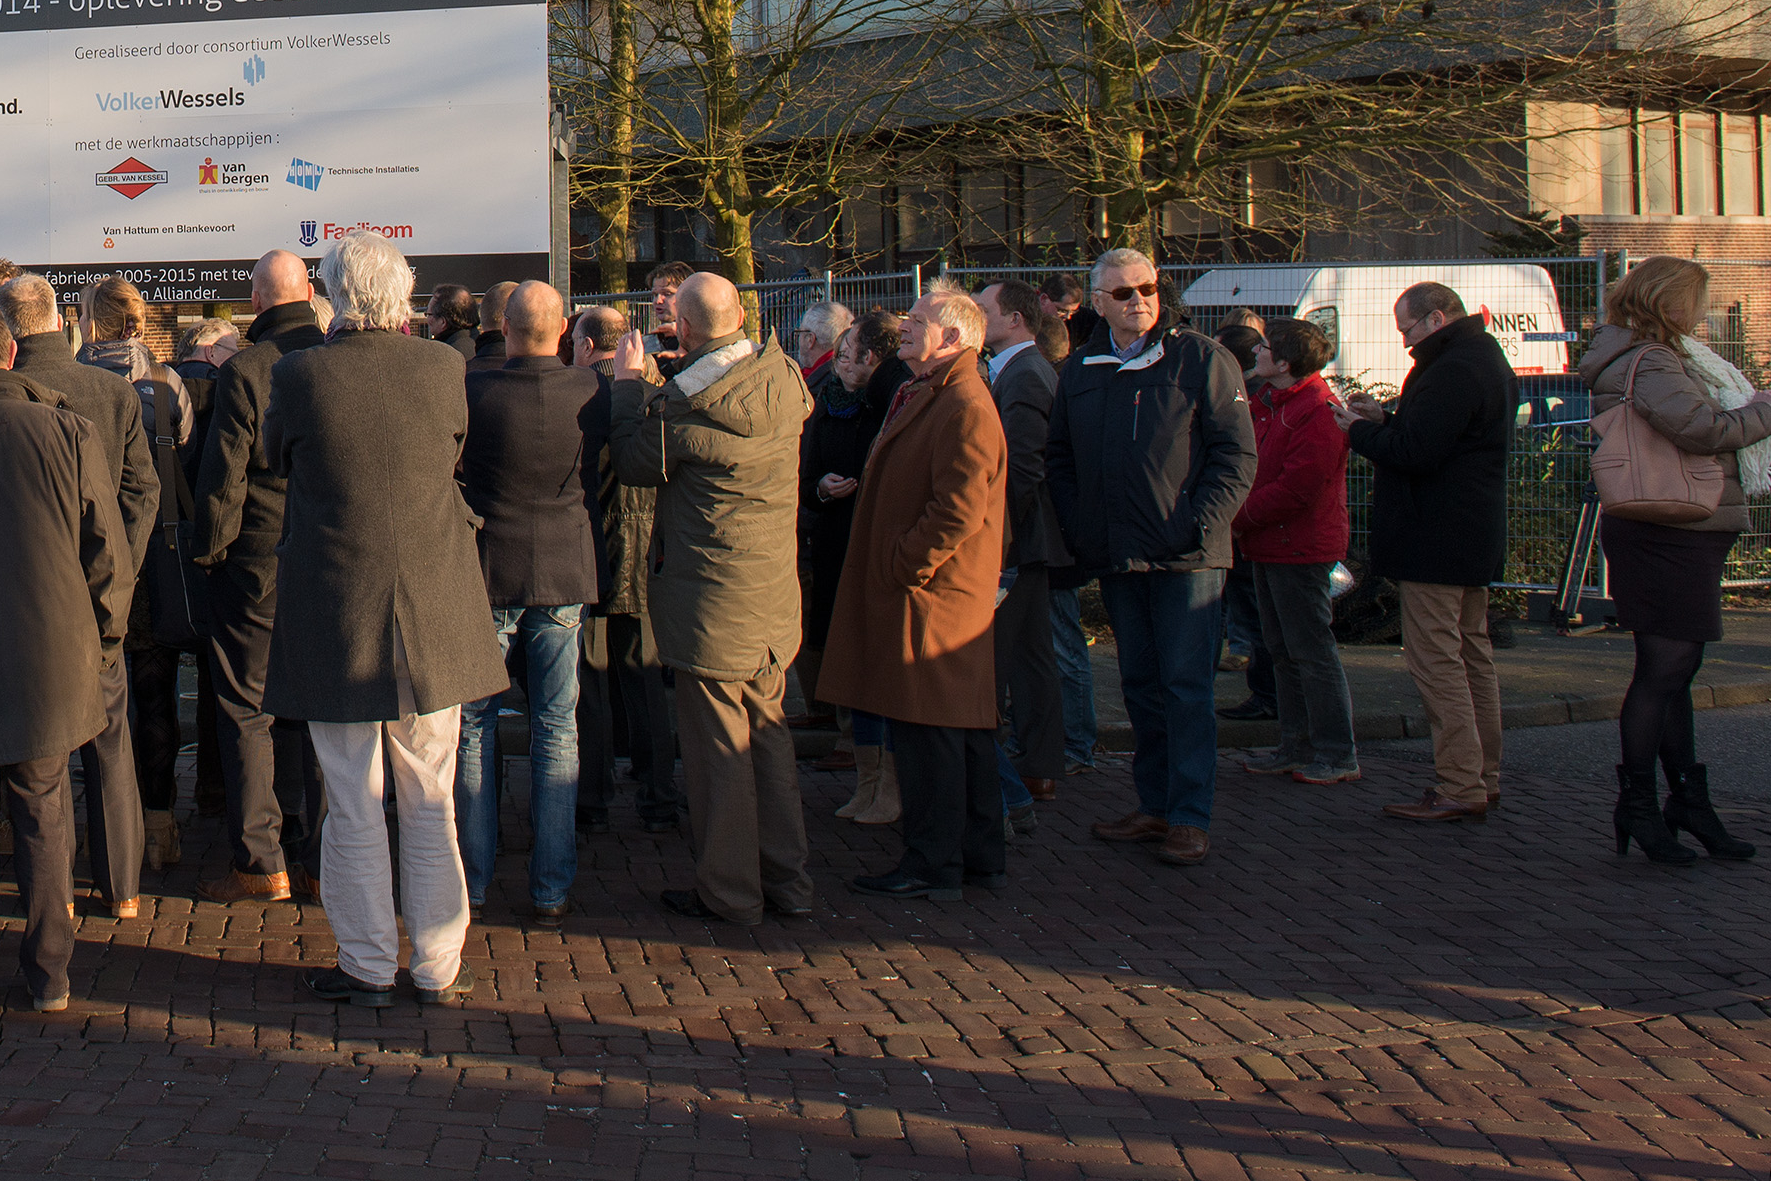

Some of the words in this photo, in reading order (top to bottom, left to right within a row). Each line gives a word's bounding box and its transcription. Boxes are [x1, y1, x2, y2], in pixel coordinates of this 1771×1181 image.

[75, 43, 161, 59] Gerealiseerd
[167, 42, 198, 55] door
[204, 38, 282, 53] consortium
[287, 32, 390, 48] VolkerWessels
[96, 87, 245, 112] VolkerWessels
[76, 139, 101, 151] met
[106, 137, 122, 150] de
[127, 134, 271, 149] werkmaatschappijen
[223, 164, 245, 172] van
[328, 167, 373, 175] Technische
[223, 173, 268, 186] bergen
[103, 227, 120, 235] Van
[177, 224, 235, 233] Blankevoort
[201, 269, 228, 281] met
[153, 286, 220, 300] Alliander.
